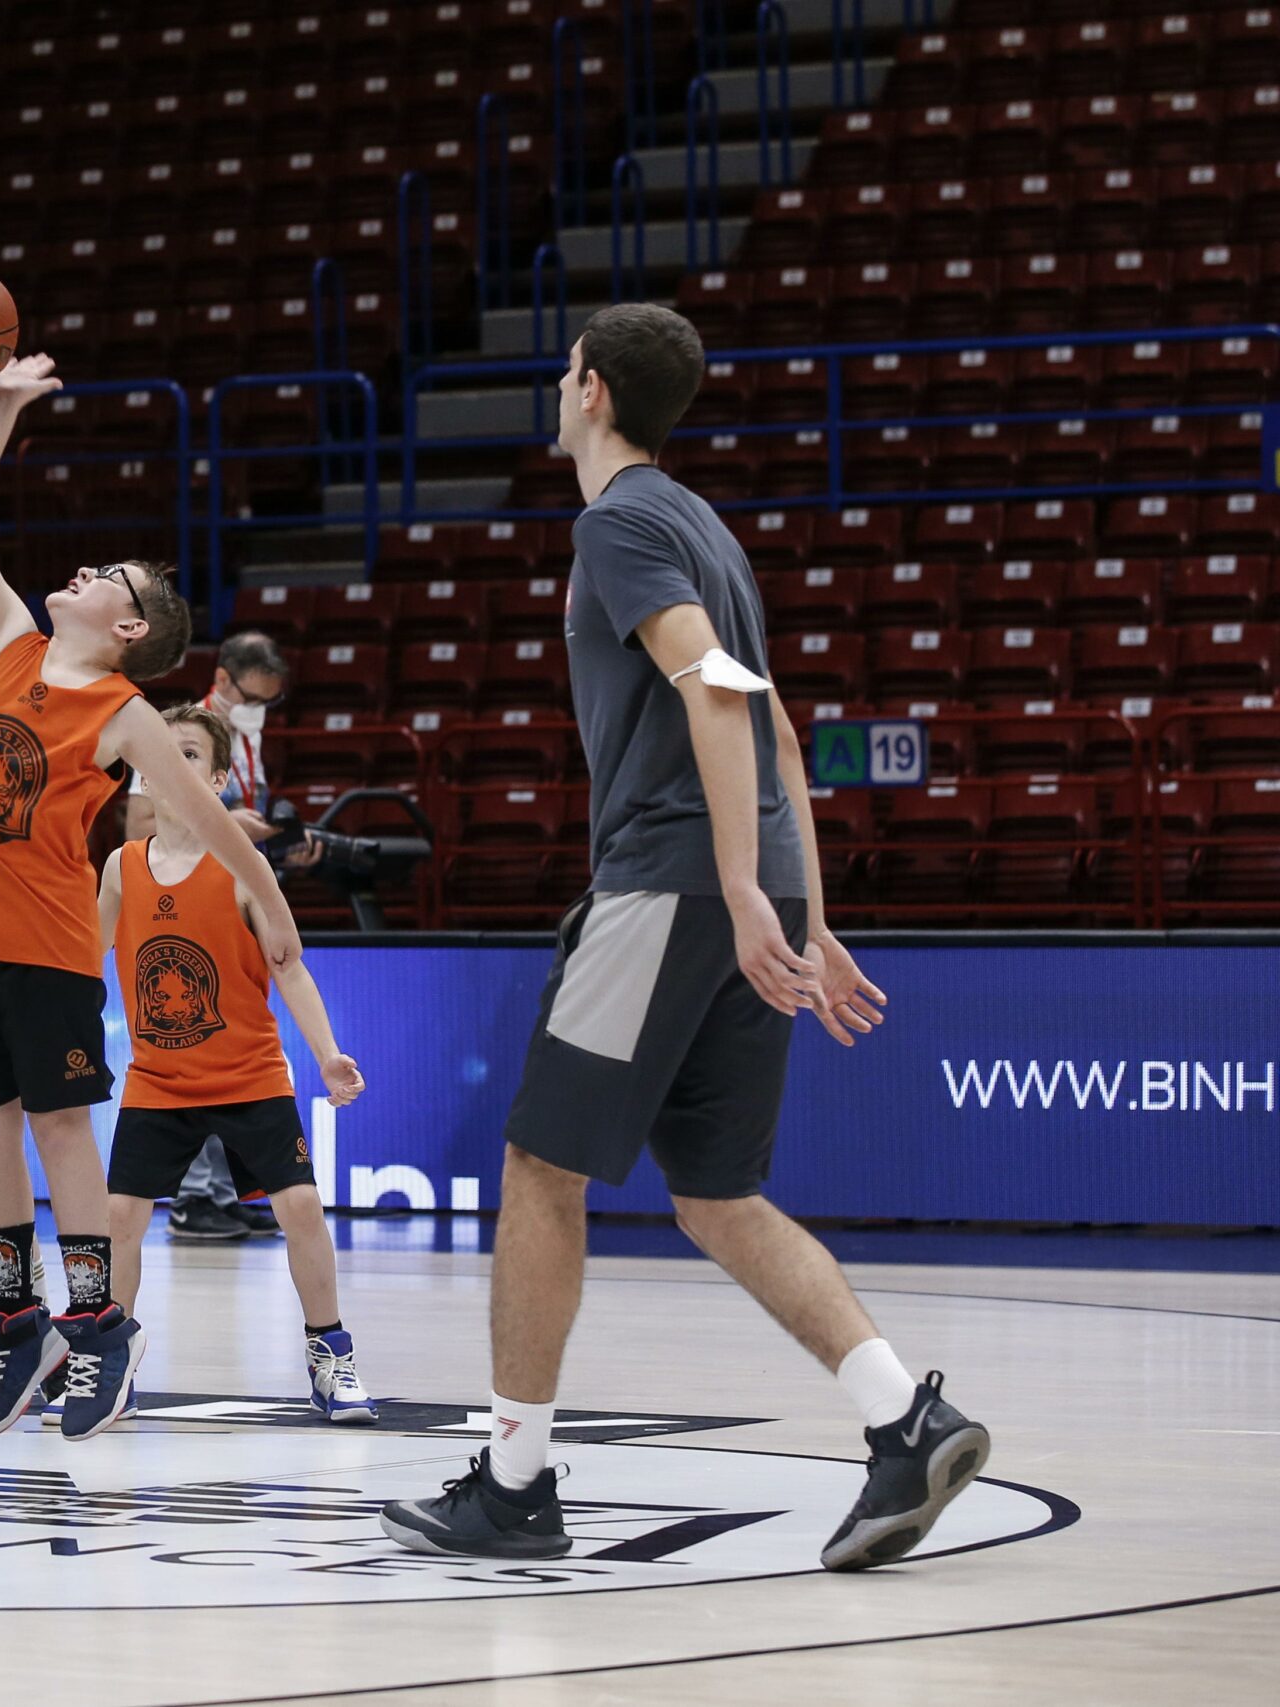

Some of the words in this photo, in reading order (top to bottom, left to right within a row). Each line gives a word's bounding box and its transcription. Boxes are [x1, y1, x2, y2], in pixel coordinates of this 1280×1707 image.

[13, 737, 35, 782] TIGERS
[824, 734, 858, 773] A
[875, 733, 916, 773] 19
[152, 912, 179, 921] BITRE
[172, 948, 206, 979] TIGERS
[155, 1032, 205, 1049] MILANO
[64, 1065, 97, 1080] BITRE
[941, 1059, 1275, 1112] WWW.BINH
